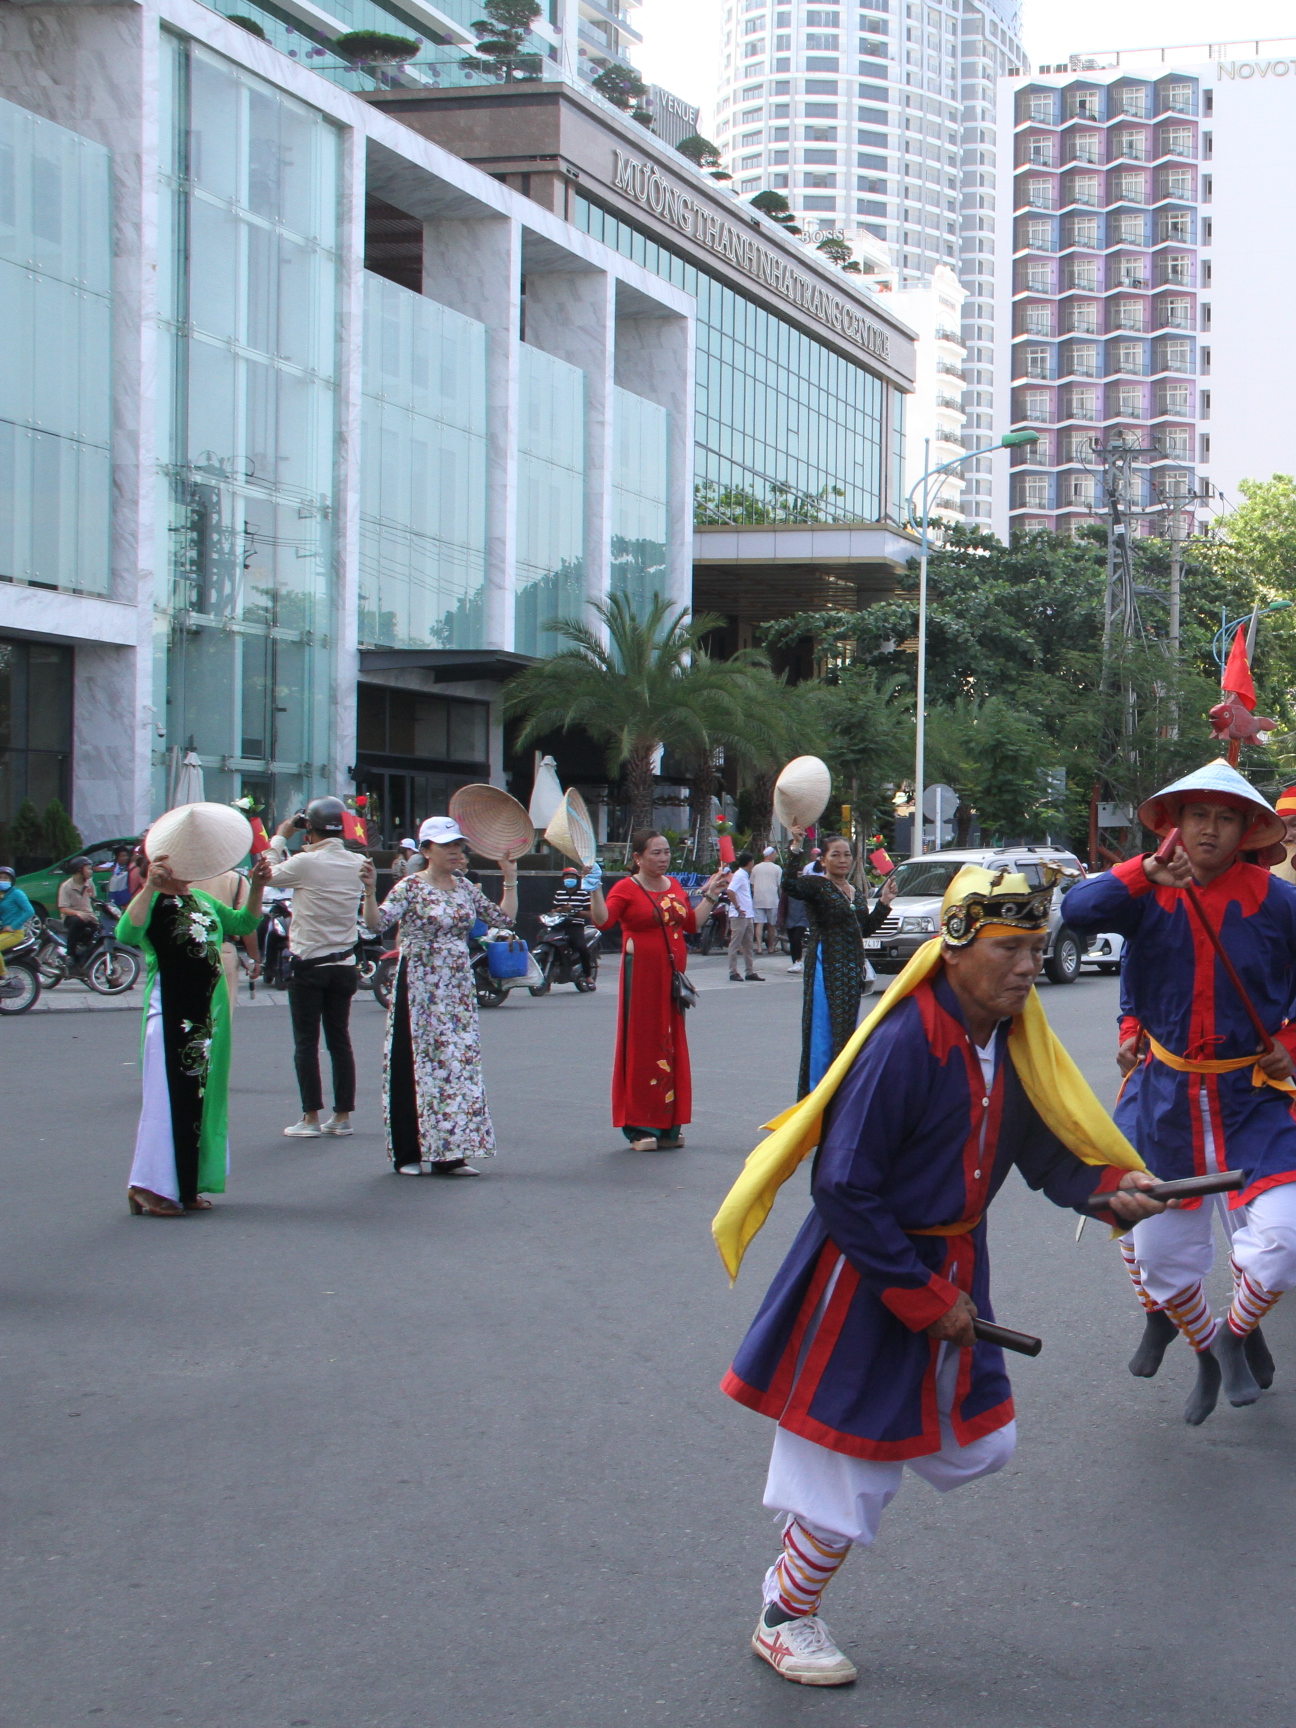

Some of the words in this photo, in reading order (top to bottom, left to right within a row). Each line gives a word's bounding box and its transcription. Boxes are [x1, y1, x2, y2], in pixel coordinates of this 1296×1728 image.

[660, 89, 695, 126] VENUE
[614, 148, 692, 232] MƯỜNG
[693, 201, 758, 275] THANH
[758, 246, 794, 299] NHA
[793, 271, 842, 330] TRANG
[842, 304, 891, 361] CENTRE
[801, 229, 845, 244] BOSS
